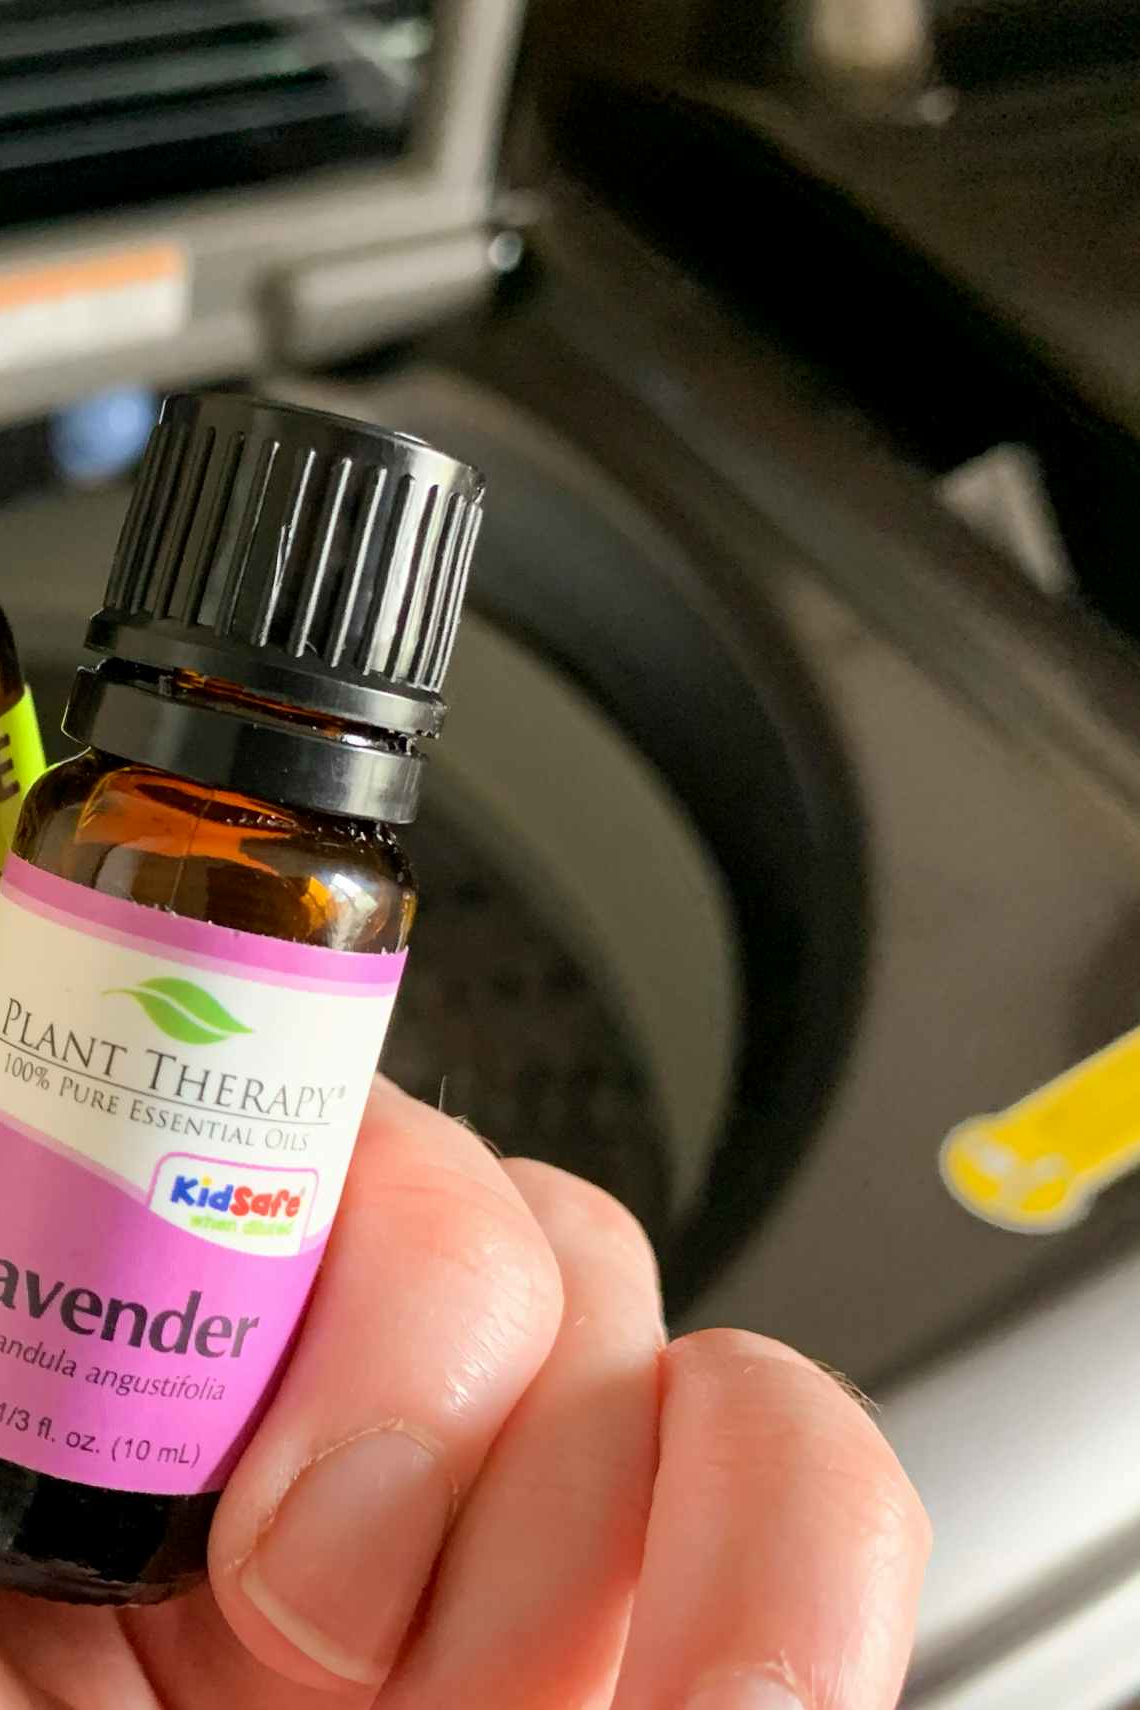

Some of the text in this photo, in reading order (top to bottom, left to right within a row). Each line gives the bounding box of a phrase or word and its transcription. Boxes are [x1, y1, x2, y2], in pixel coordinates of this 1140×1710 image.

[1, 998, 127, 1078] PLANT
[4, 1051, 309, 1151] 100% PURE ESSENTIAL OILS
[85, 1365, 226, 1402] angustifolia
[37, 1417, 57, 1443] fl.
[65, 1432, 100, 1453] oz.
[111, 1437, 151, 1462] (10
[157, 1442, 201, 1468] mL)
